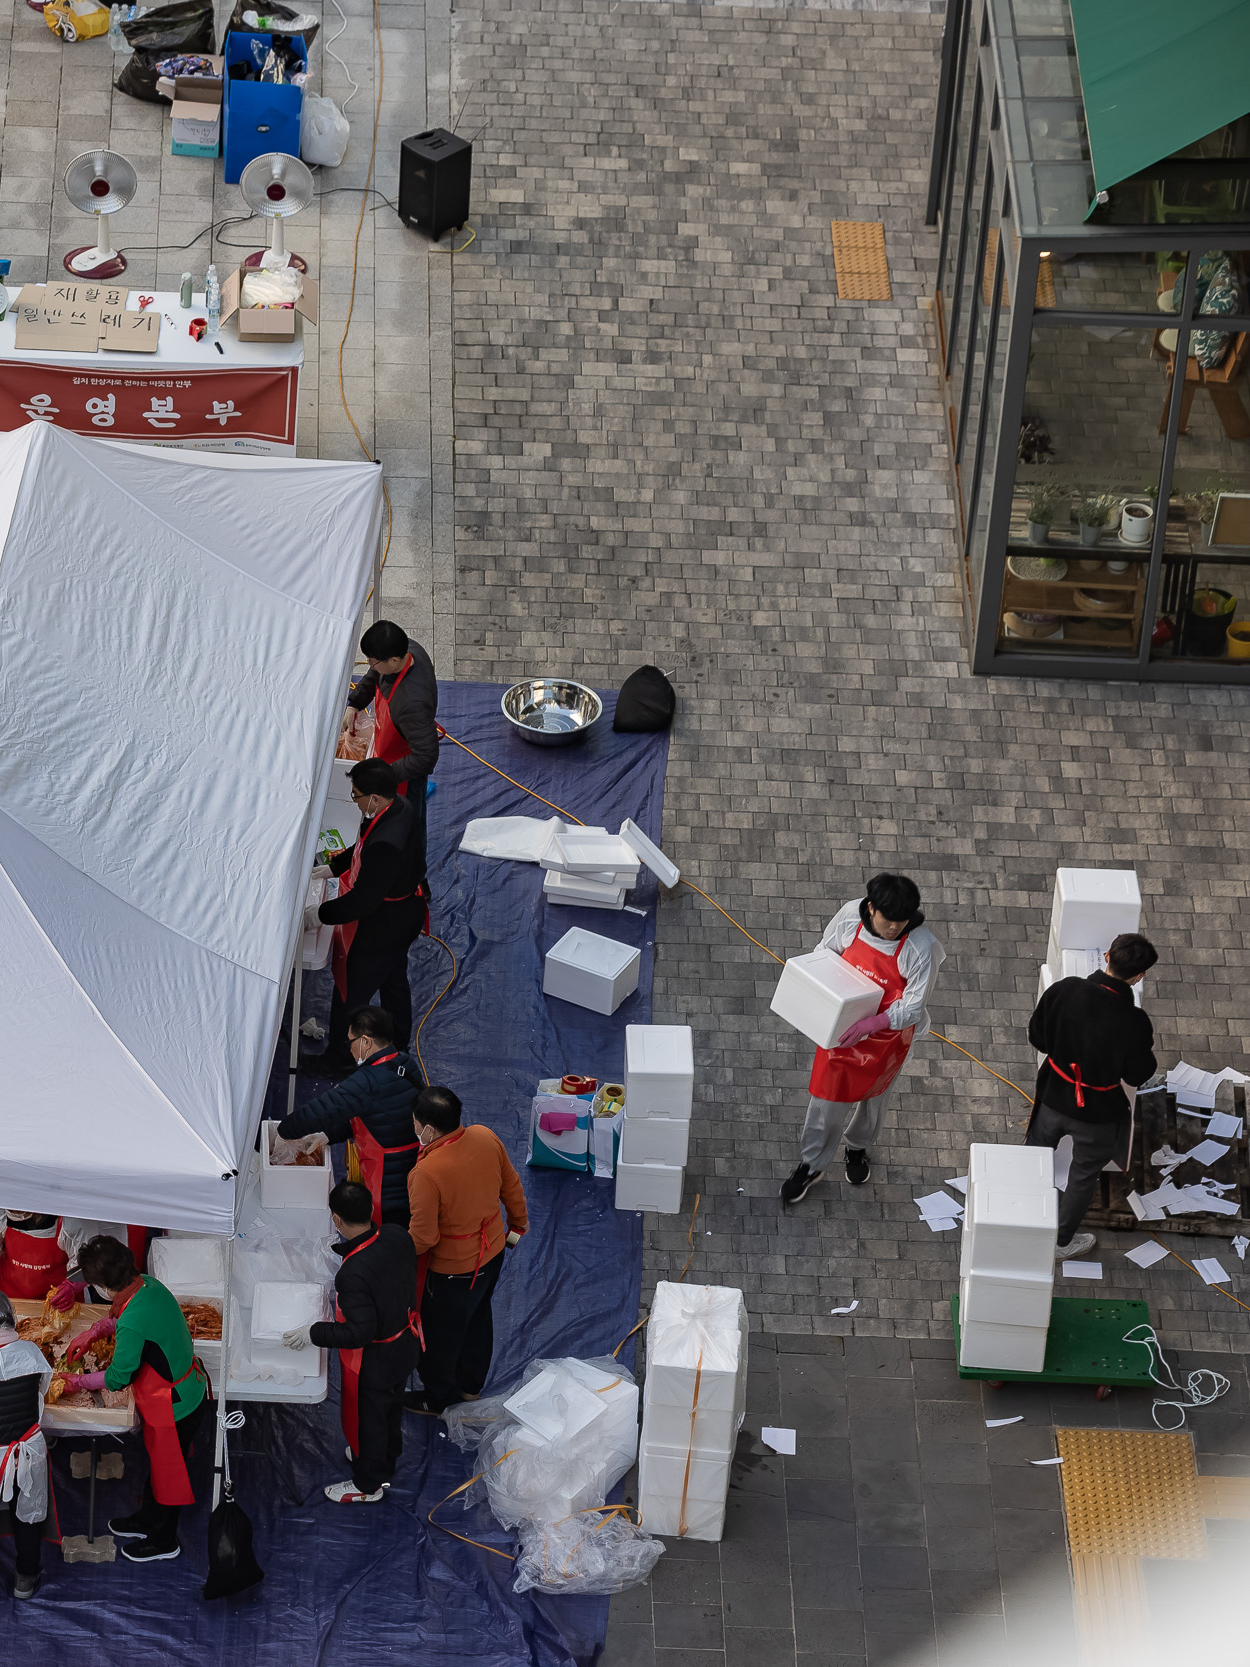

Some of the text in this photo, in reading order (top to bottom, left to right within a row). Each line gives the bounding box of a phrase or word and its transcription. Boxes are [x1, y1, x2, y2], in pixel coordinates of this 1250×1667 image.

[72, 376, 192, 388] 김치 한상자로 전하는 따뜻한 안부
